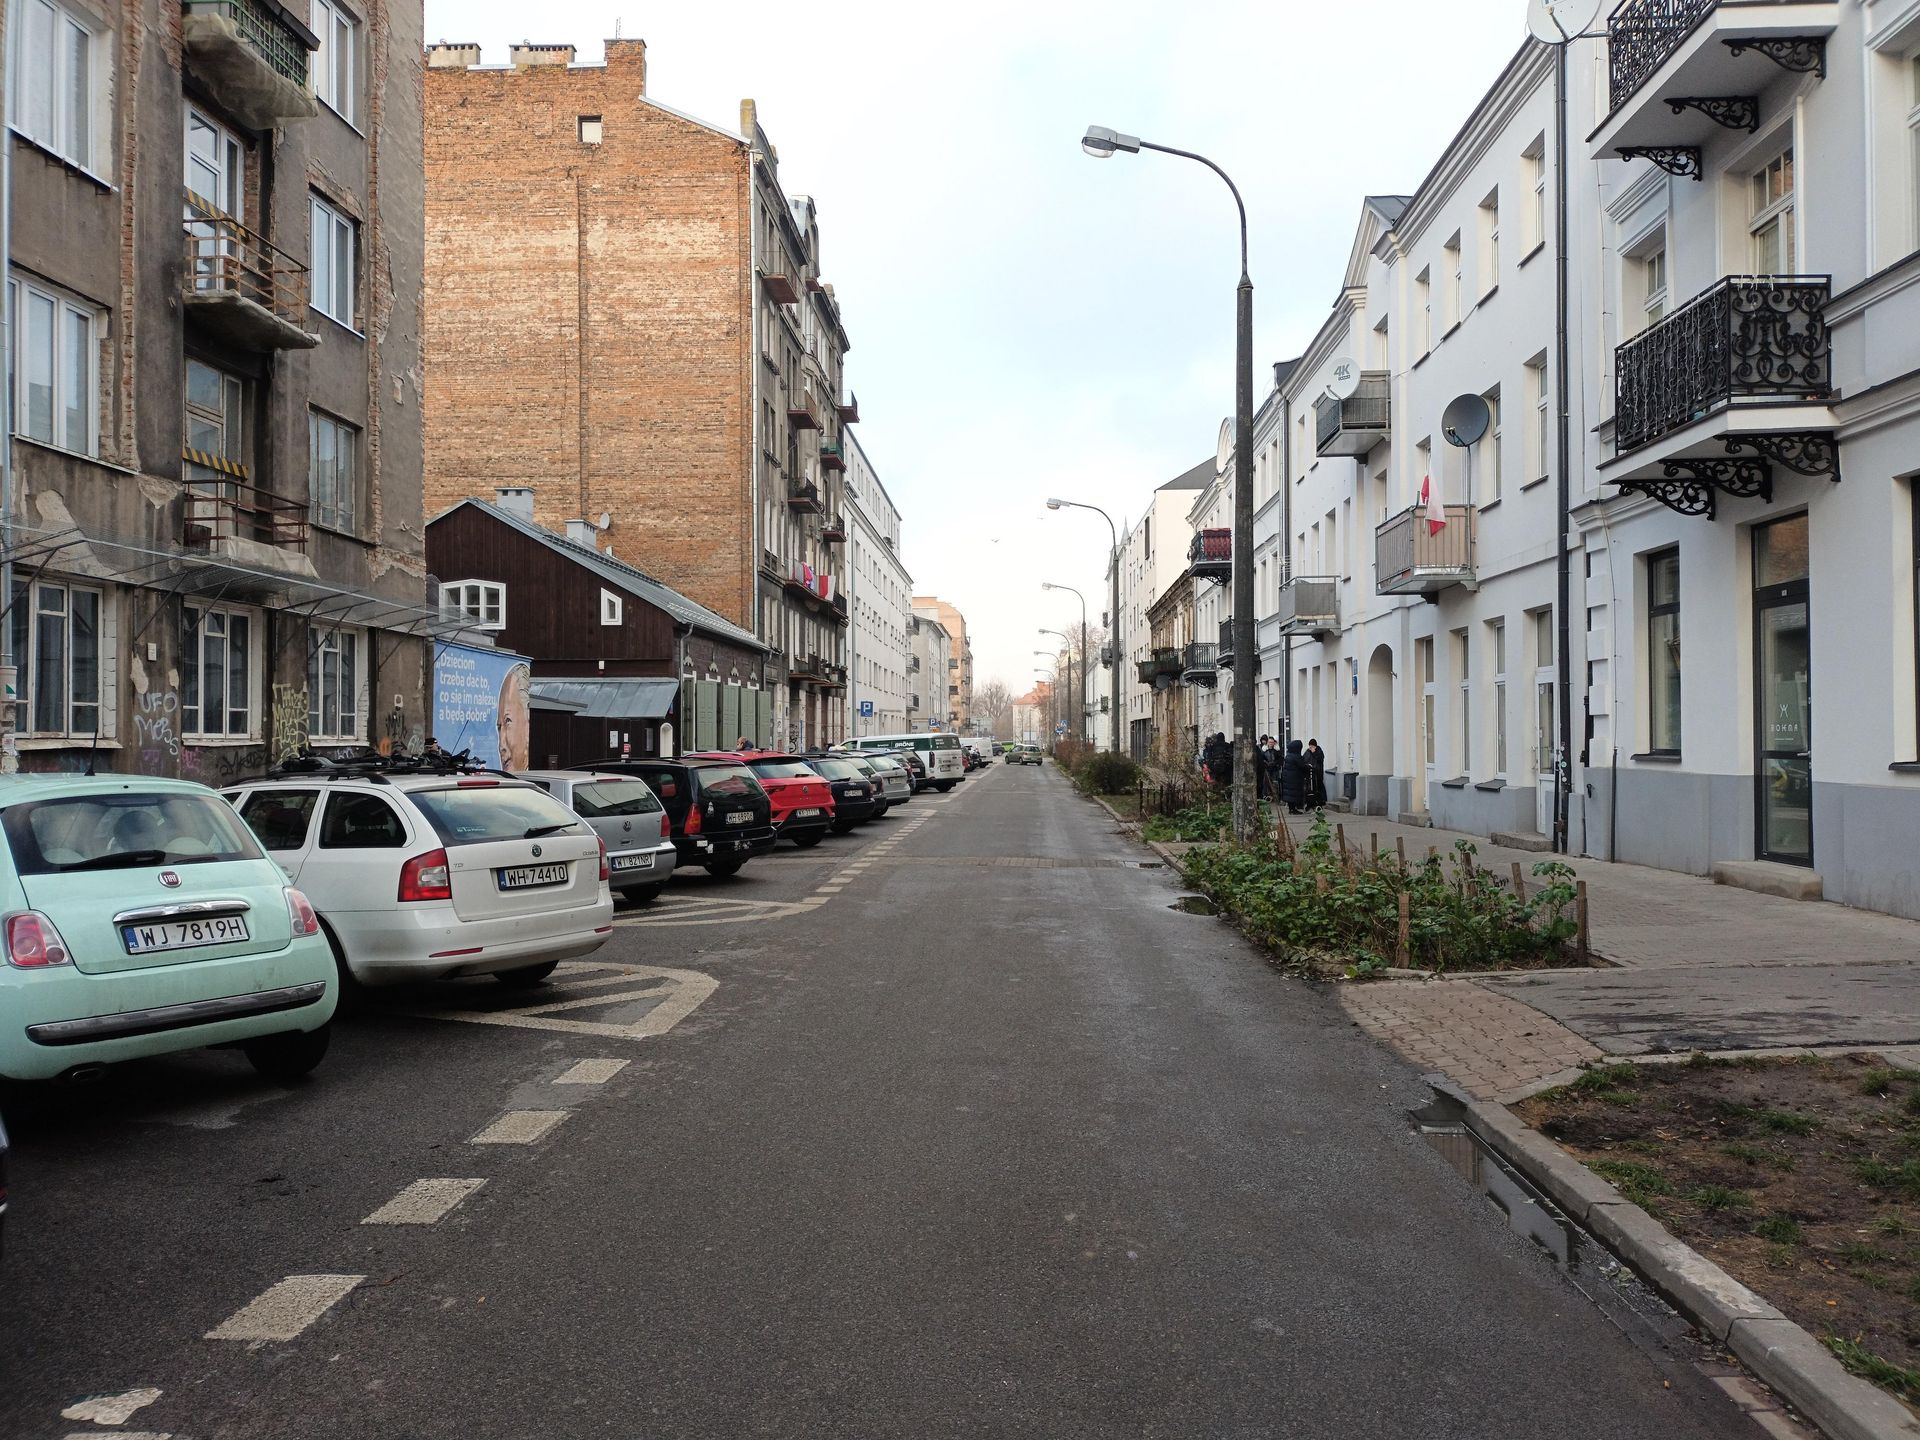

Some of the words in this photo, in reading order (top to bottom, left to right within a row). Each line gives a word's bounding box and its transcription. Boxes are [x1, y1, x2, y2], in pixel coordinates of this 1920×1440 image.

[1334, 364, 1350, 376] 4K
[440, 670, 465, 687] trzeba
[138, 691, 178, 713] UFO
[440, 691, 449, 704] co
[463, 690, 473, 705] im
[439, 708, 445, 721] a
[164, 874, 177, 882] FIAT
[508, 870, 526, 885] WH
[529, 866, 565, 883] 74410
[140, 926, 168, 946] WJ
[176, 919, 242, 943] 7819H
